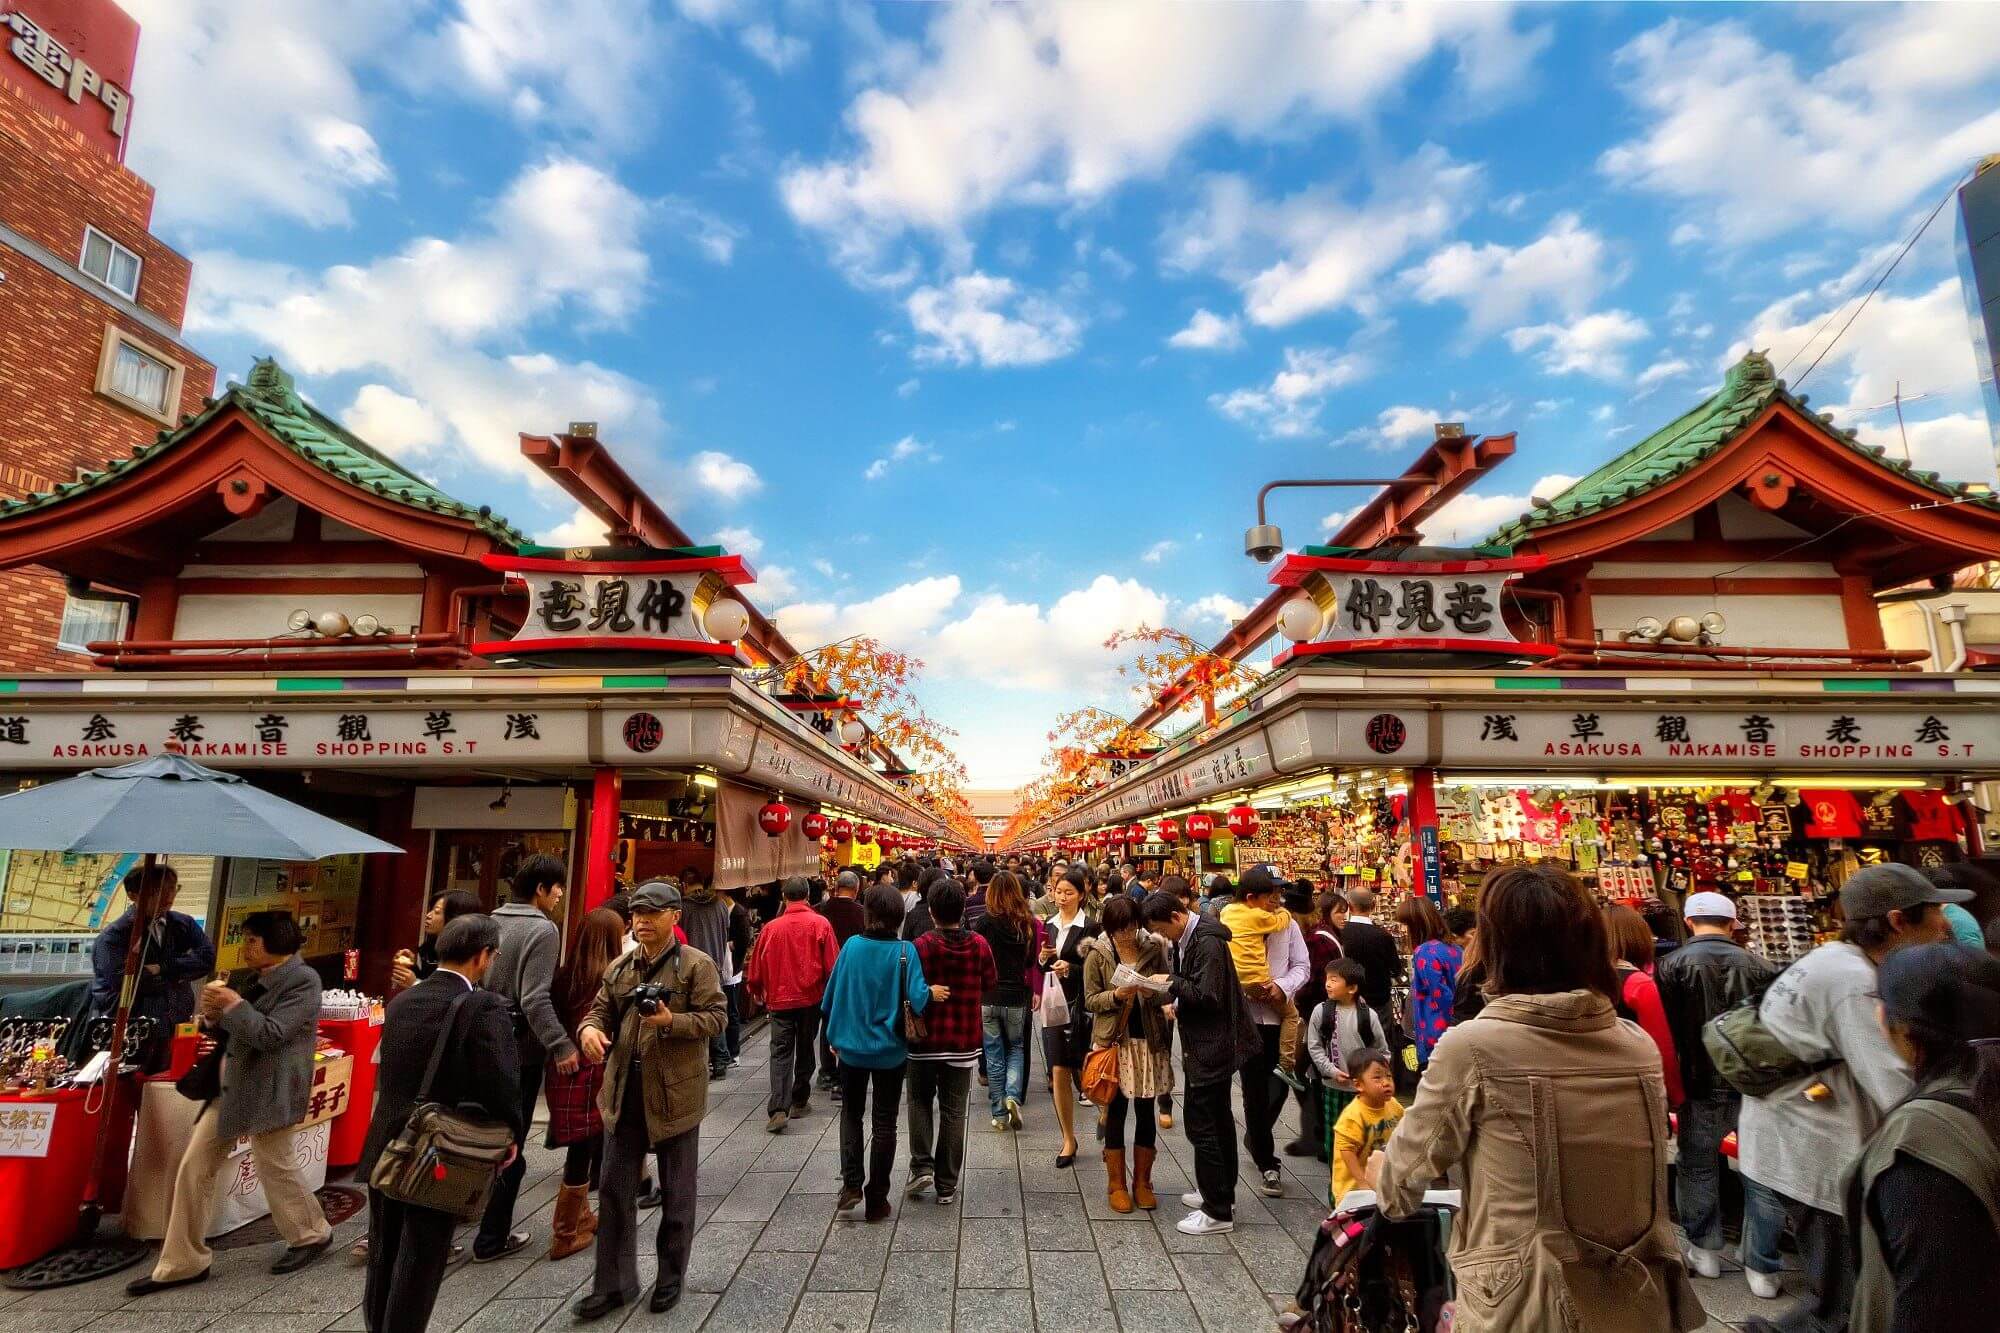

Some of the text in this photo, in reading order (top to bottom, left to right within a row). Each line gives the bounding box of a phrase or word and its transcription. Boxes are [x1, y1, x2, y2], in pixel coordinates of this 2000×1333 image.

[1346, 579, 1494, 633] 仲見世
[53, 741, 478, 757] ASAKUSA NAKAMISE SHOPPING S.T
[1544, 743, 1975, 758] ASAKUSA NAKAMISE SHOPPING S.T
[304, 1081, 345, 1121] 辛子
